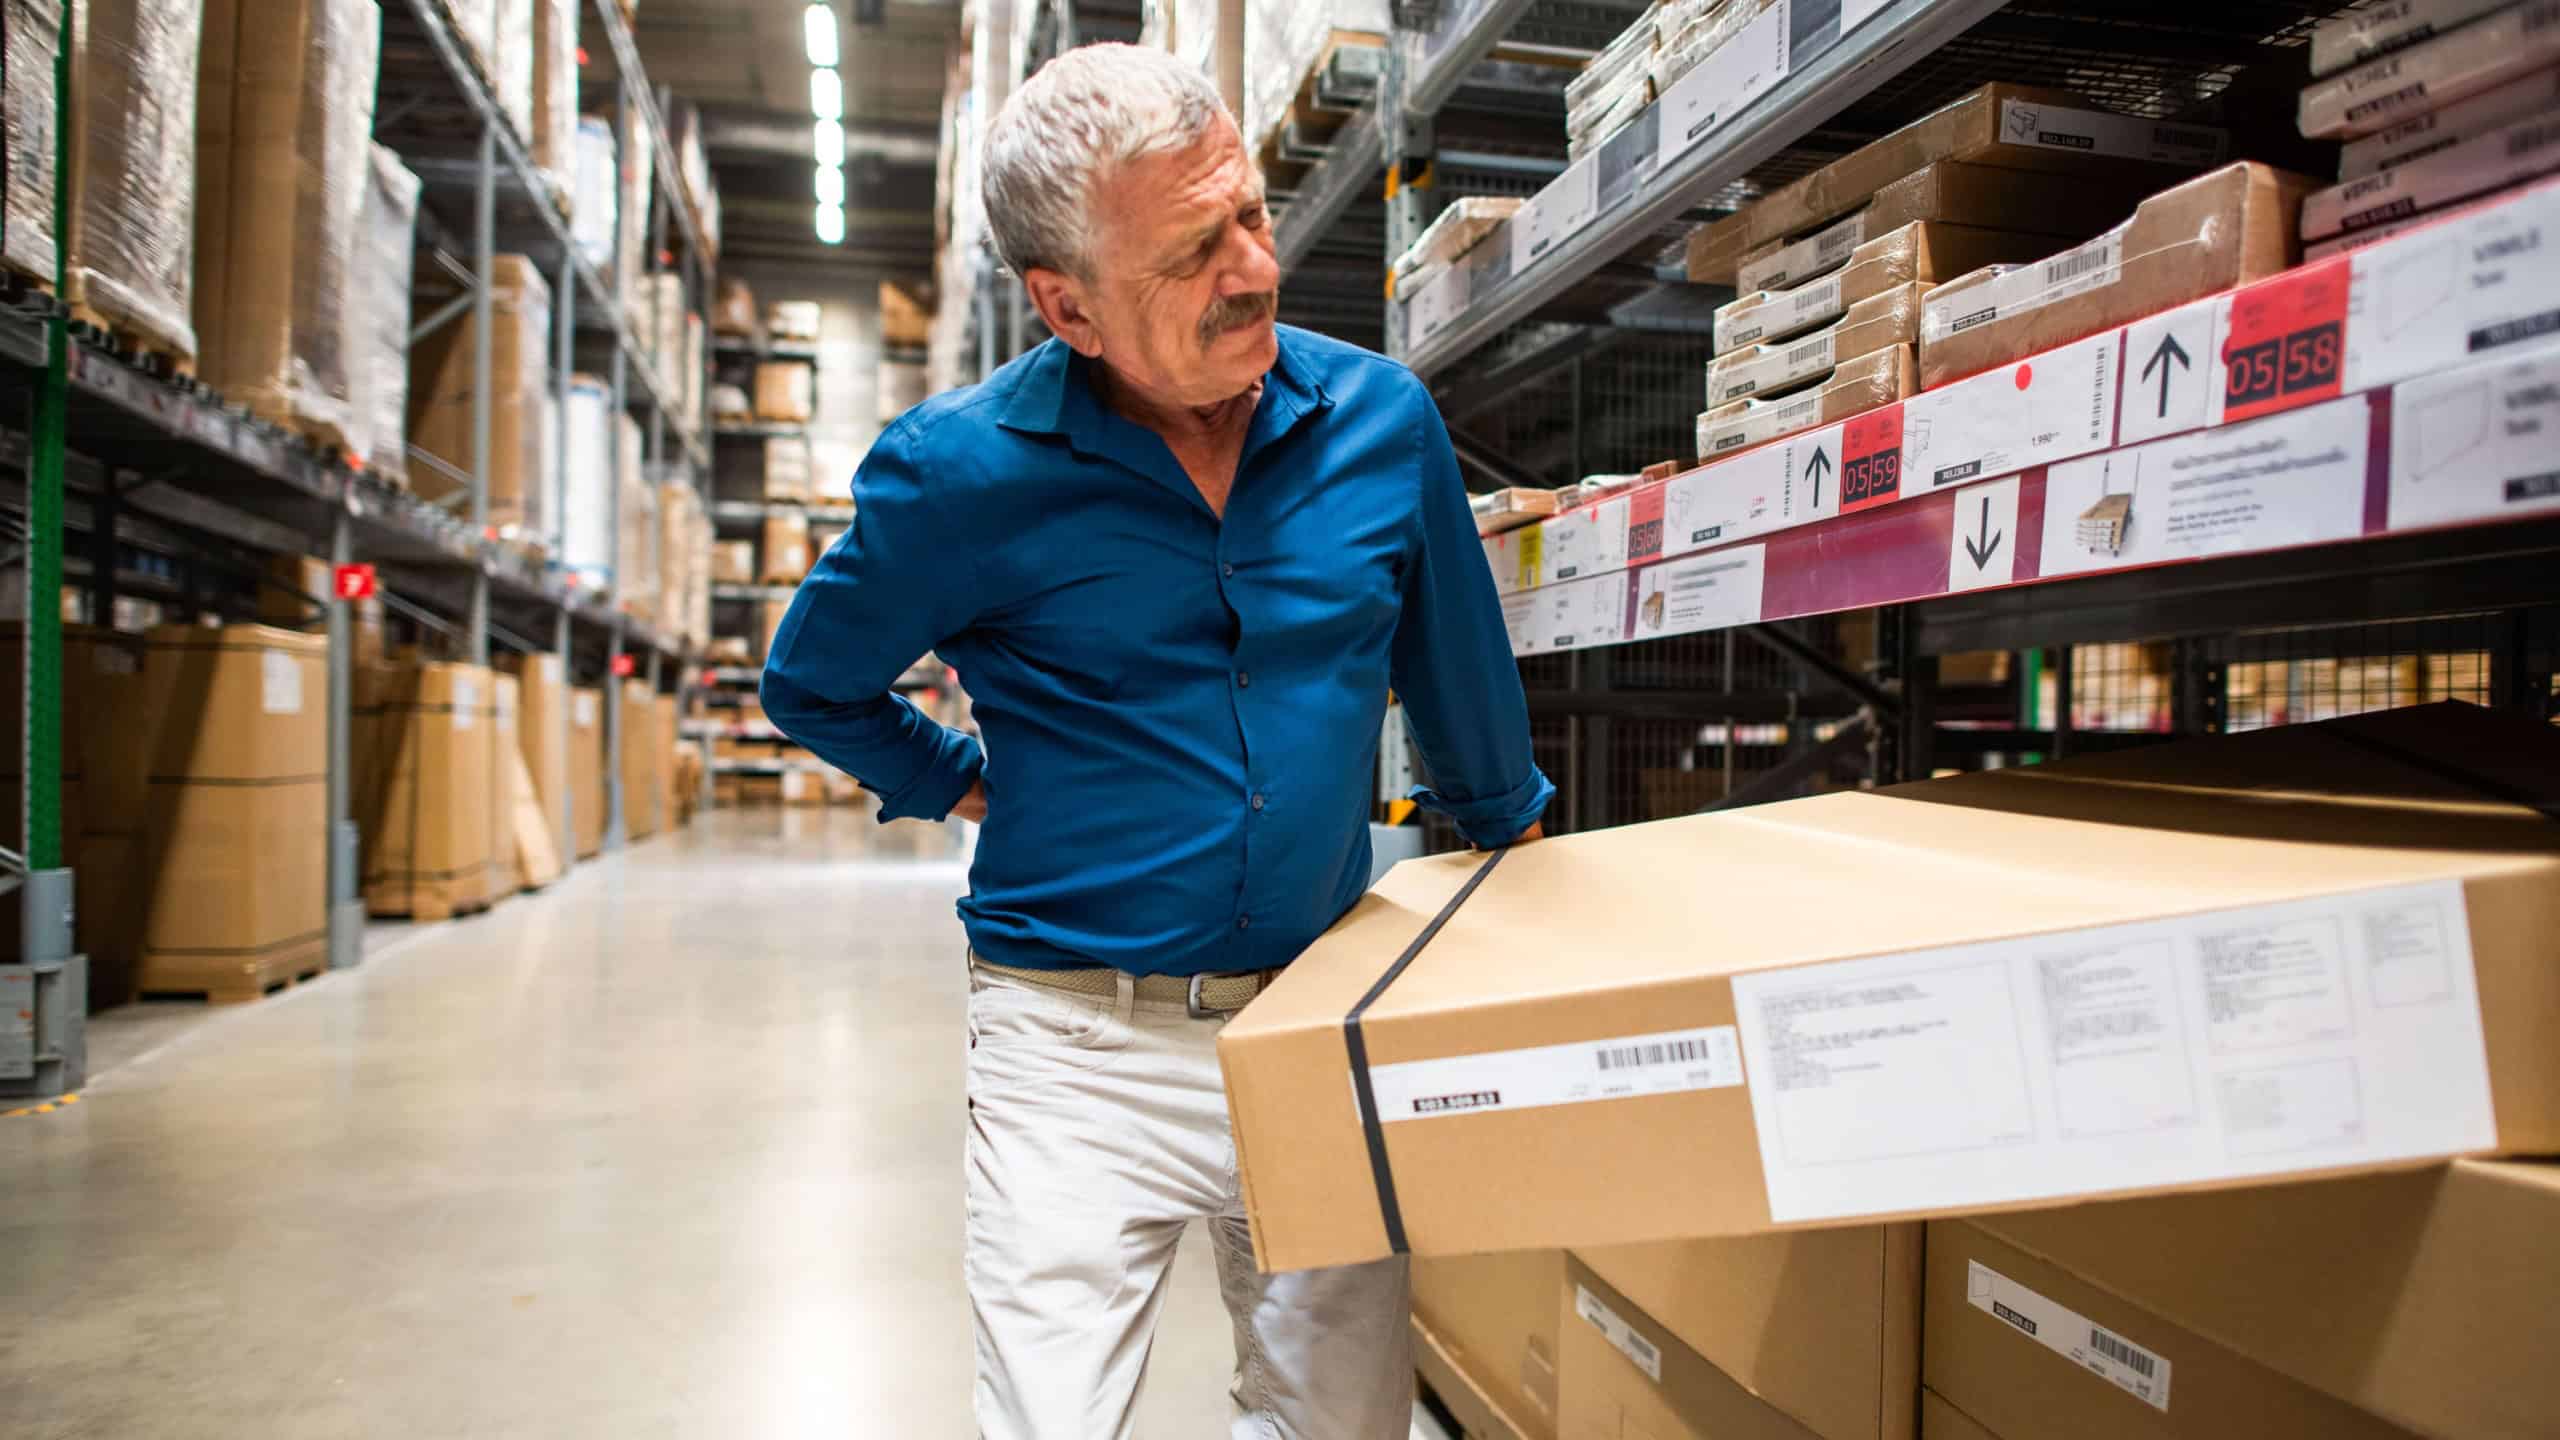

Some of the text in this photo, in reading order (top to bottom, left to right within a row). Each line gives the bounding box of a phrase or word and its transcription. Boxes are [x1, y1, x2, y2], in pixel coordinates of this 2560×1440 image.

[2228, 332, 2337, 397] 05 58
[1845, 455, 1898, 495] 05 59
